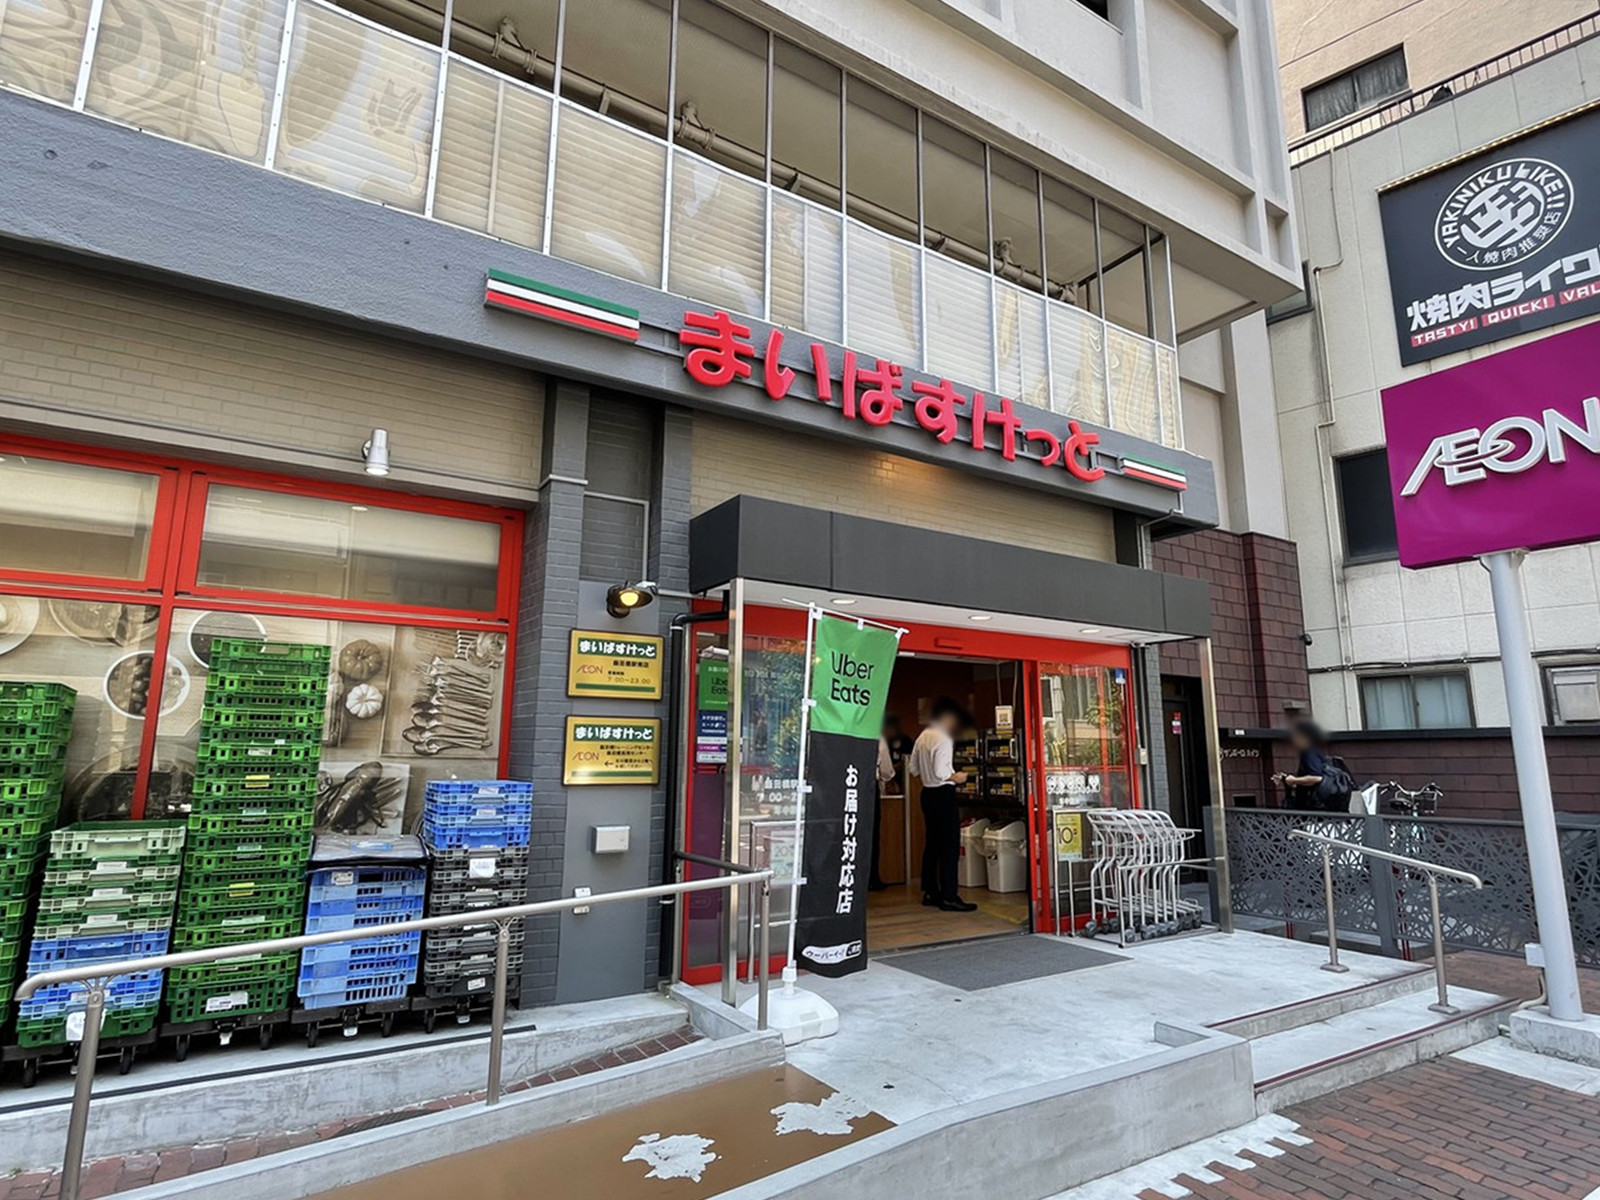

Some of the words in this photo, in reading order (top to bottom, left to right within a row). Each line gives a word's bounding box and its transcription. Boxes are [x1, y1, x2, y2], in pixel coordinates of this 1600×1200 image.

[1442, 165, 1511, 248] YAKINIKU
[1414, 319, 1475, 345] TASTY!
[1488, 298, 1547, 323] QUICK!
[680, 310, 1106, 483] まいばすけっと
[1400, 397, 1600, 497] AEON
[579, 640, 656, 657] まいばすけっと
[576, 664, 604, 674] AEON
[832, 651, 875, 680] Uber
[831, 677, 871, 706] Eats
[575, 726, 653, 740] まいばすけっと
[572, 751, 599, 761] AEON
[835, 764, 859, 914] お届け対応店
